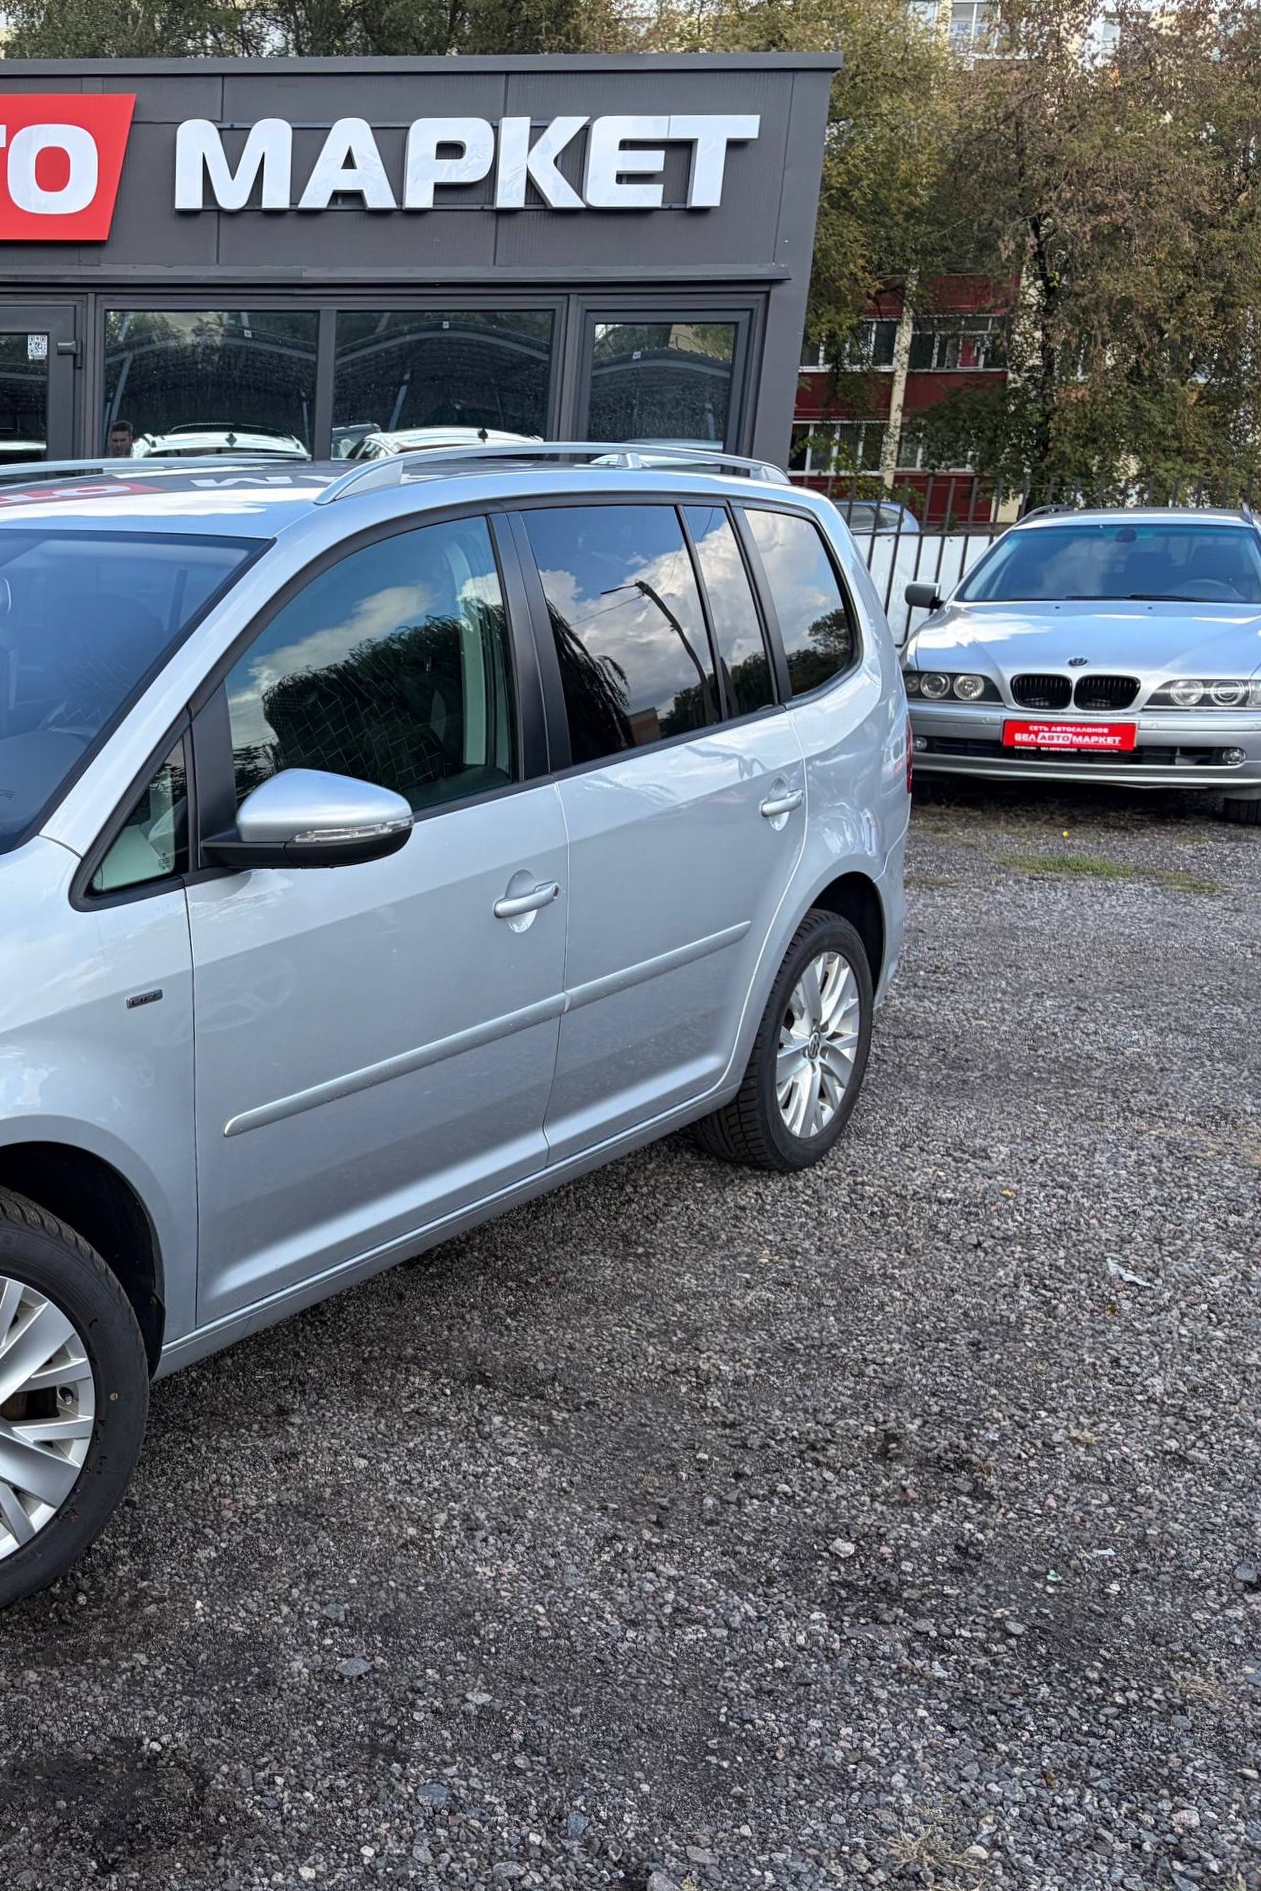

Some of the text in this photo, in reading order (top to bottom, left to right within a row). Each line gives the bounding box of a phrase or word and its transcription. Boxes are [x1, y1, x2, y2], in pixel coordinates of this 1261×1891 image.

[174, 114, 761, 211] МАРКЕТ
[1051, 726, 1109, 734] АВТОСАЛОНОВ
[1014, 733, 1122, 745] БЕЛ АВТО МАРКЕТ
